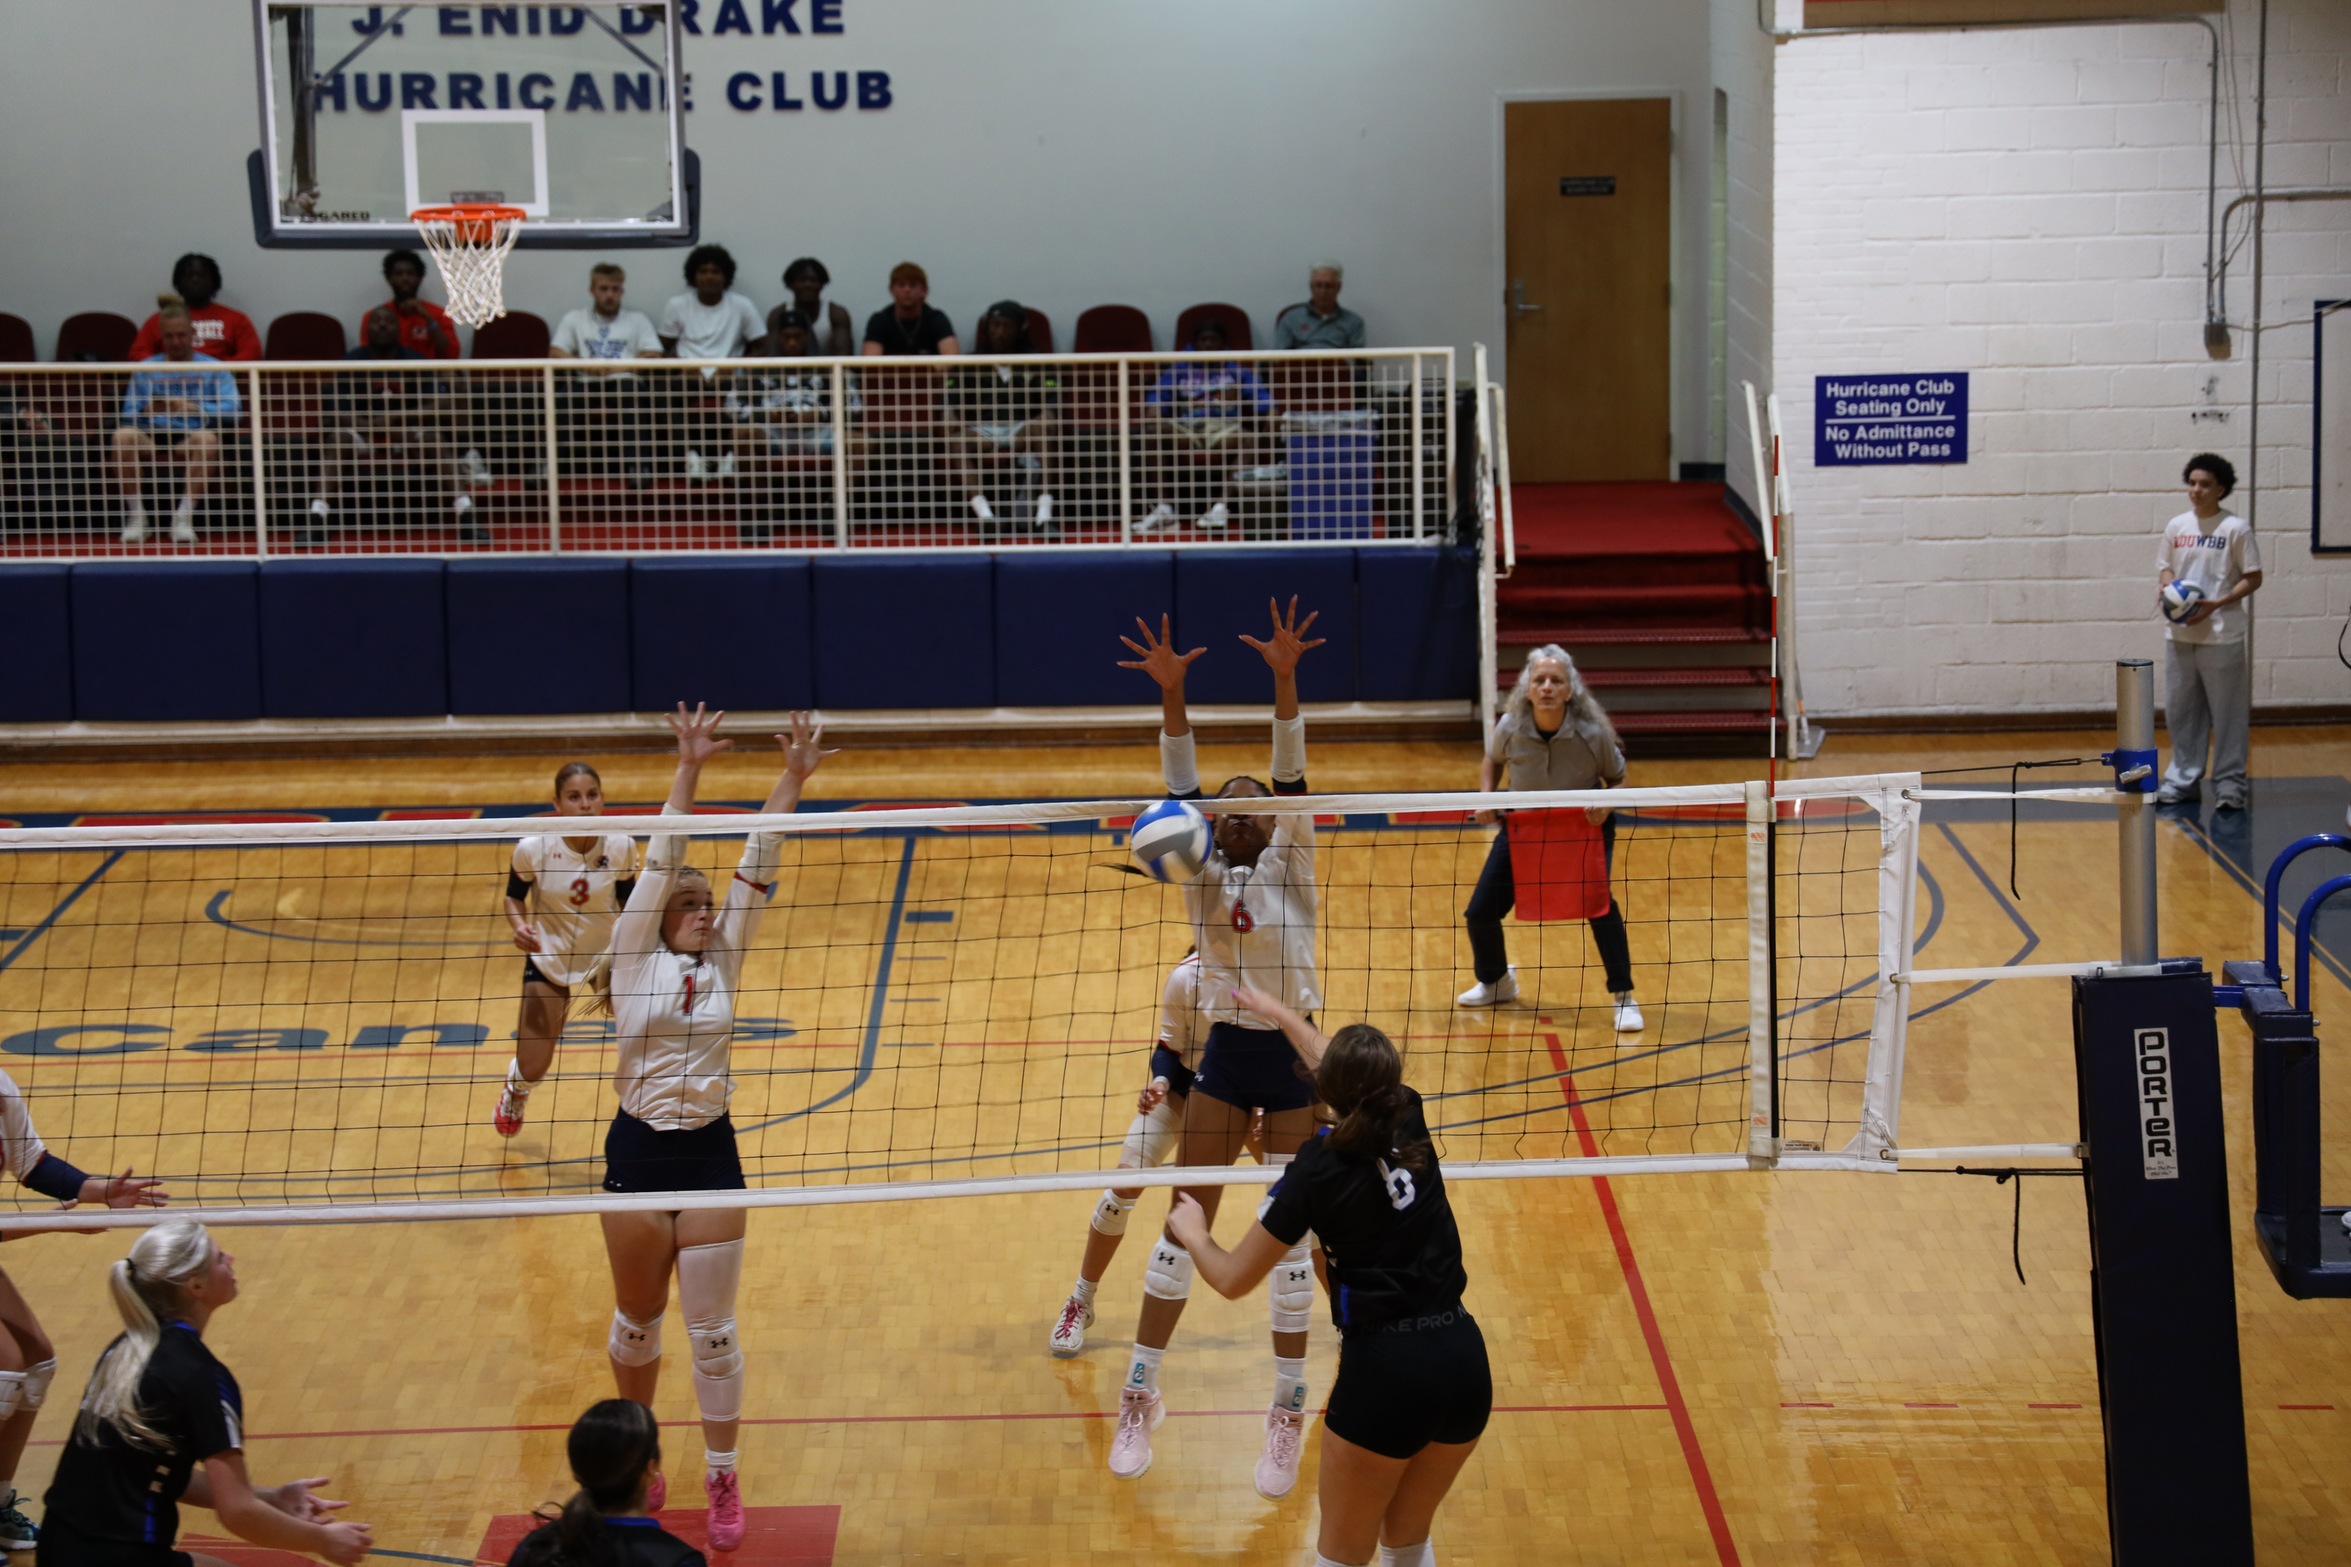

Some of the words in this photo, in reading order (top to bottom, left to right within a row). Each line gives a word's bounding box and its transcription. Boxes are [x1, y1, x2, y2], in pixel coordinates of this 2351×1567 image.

[352, 6, 404, 36] J.
[438, 6, 586, 36] ENID
[620, 0, 845, 36] DRAKE
[726, 71, 893, 111] CLUB
[1826, 381, 1911, 398] Hurricane
[1915, 379, 1955, 395] Club
[1835, 399, 1901, 417] Seating
[1906, 397, 1946, 416] Only
[1825, 426, 1849, 441] No
[1855, 424, 1955, 441] Admittance
[1835, 443, 1903, 459] Without
[1908, 441, 1951, 457] Pass
[569, 878, 590, 906] 3
[1231, 898, 1254, 934] 6
[682, 974, 695, 1016] 1
[1417, 1311, 1454, 1331] PRO
